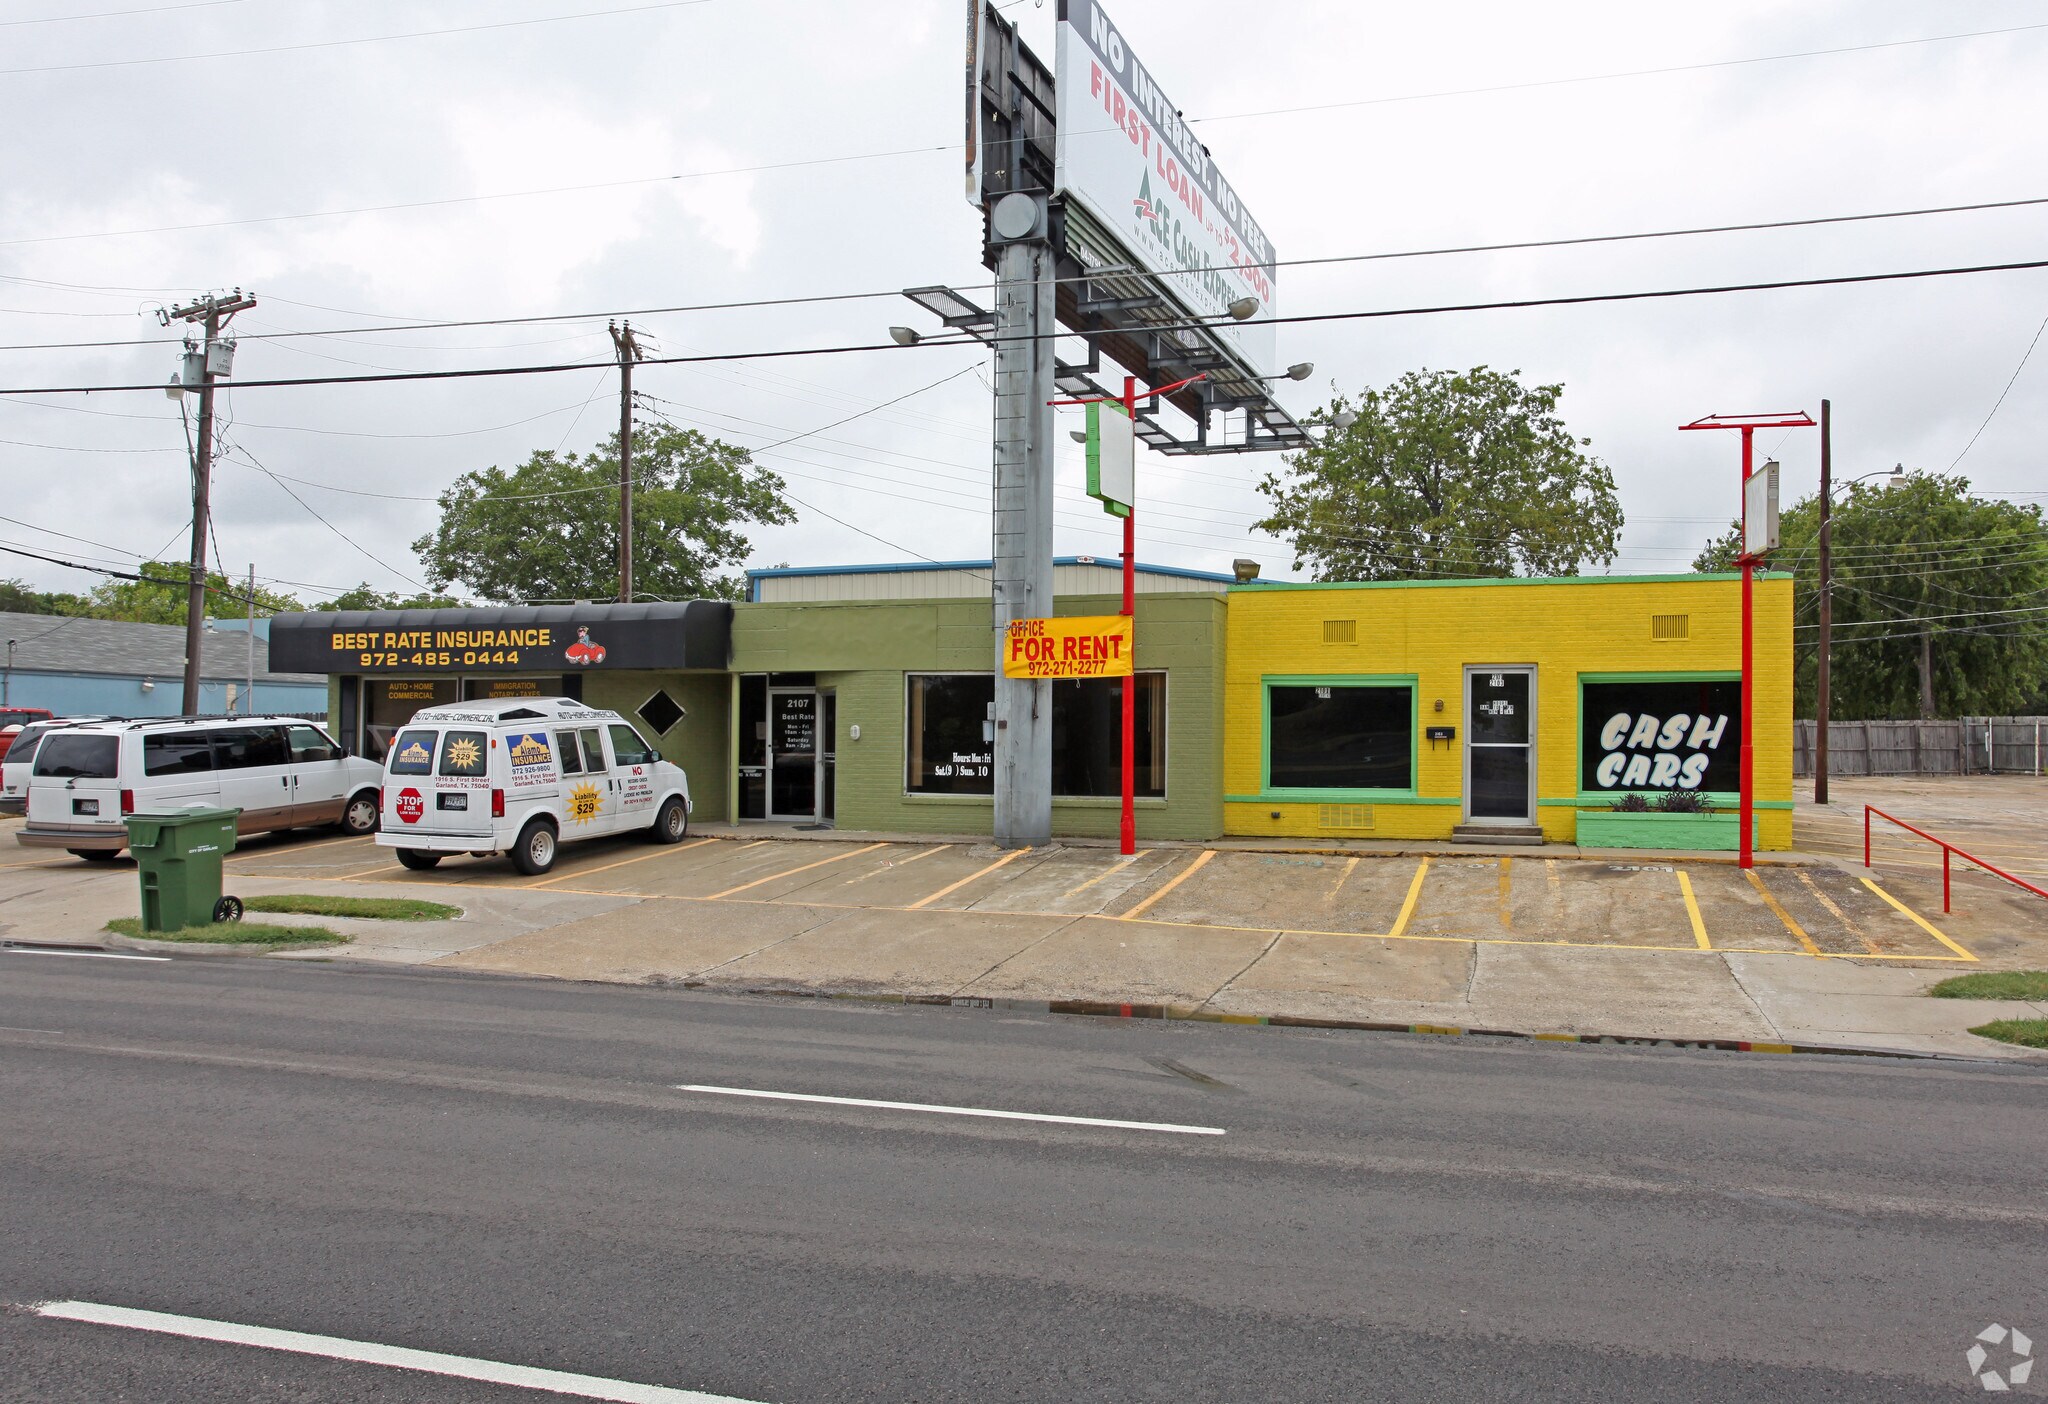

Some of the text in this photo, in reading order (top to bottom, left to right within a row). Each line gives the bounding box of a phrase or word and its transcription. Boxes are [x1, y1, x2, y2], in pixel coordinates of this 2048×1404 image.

[1091, 2, 1269, 268] NO INTEREST. NO FEES.
[1091, 59, 1151, 159] FIRST
[1157, 143, 1203, 224] LOAN
[1225, 226, 1269, 303] $2,500
[1134, 165, 1240, 311] ACE CASH EXPRE
[1011, 621, 1045, 637] OFFICE
[332, 629, 550, 650] BEST RATE INSURANCE
[1011, 635, 1124, 661] FOR RENT
[1028, 660, 1106, 676] 972-271-2277
[389, 683, 408, 691] AUTO
[494, 682, 536, 690] IMMIGRATION
[388, 692, 434, 700] COMMERCIAL
[787, 699, 809, 708] 2107
[1600, 712, 1728, 751] CASH
[408, 749, 423, 757] Alamo
[520, 746, 540, 755] Alamo
[399, 756, 429, 764] INSURANCE
[455, 753, 471, 761] $29
[512, 754, 552, 766] INSURANCE
[632, 766, 642, 776] NO
[978, 766, 988, 777] 10
[1596, 751, 1709, 789] CARS
[396, 795, 423, 806] STOP
[577, 803, 594, 815] $29
